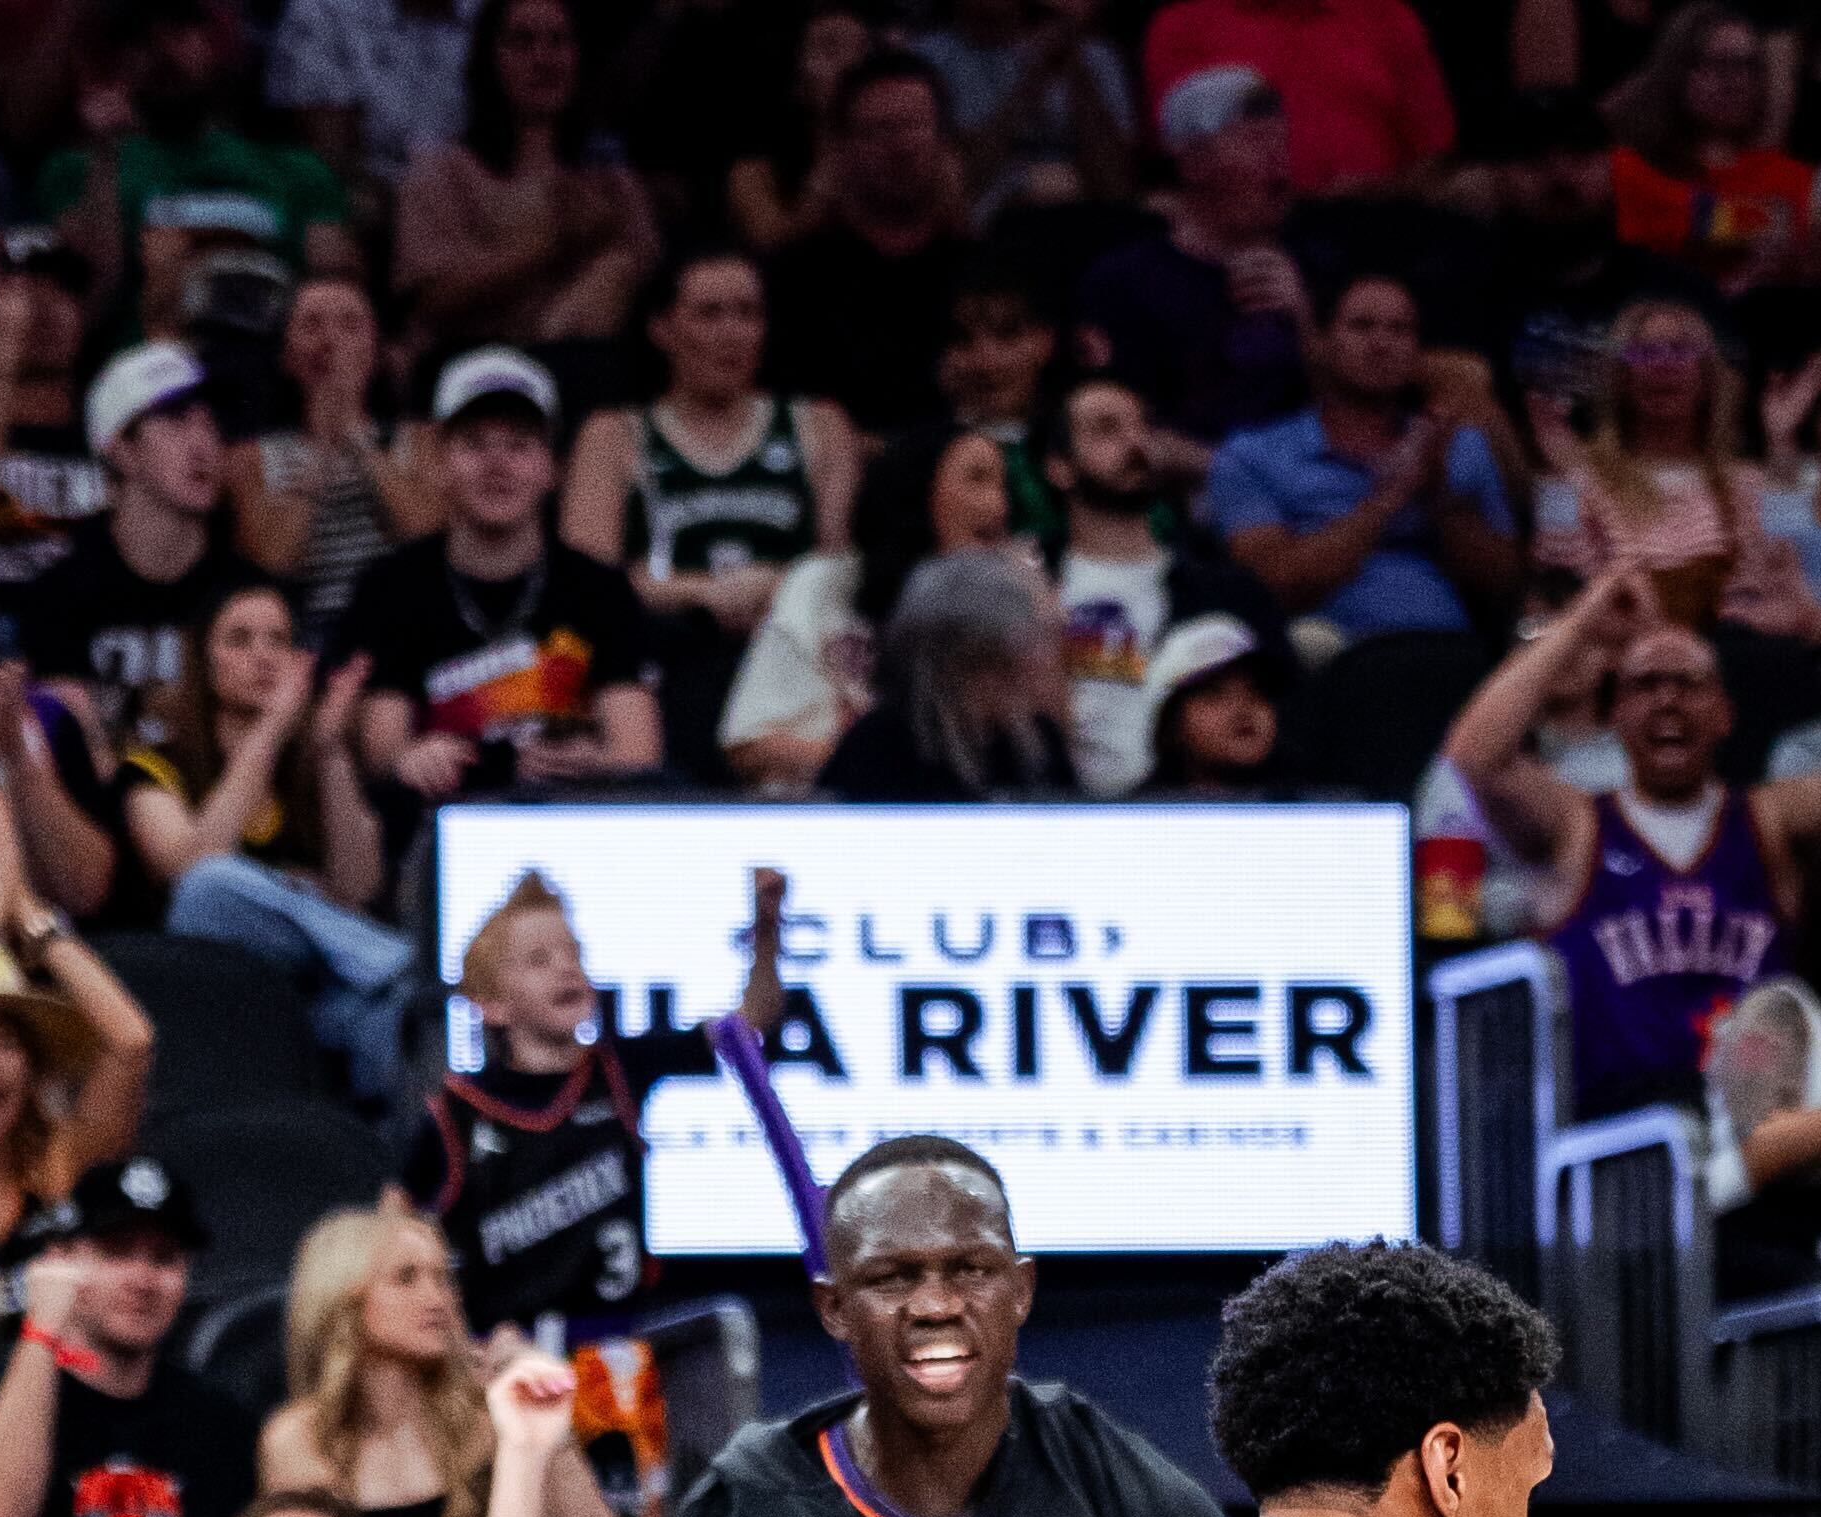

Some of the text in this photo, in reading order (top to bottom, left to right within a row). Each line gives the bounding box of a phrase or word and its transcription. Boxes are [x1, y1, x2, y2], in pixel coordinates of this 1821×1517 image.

[782, 912, 1074, 962] CLUB
[900, 982, 1373, 1077] RIVER
[595, 1219, 641, 1303] 3
